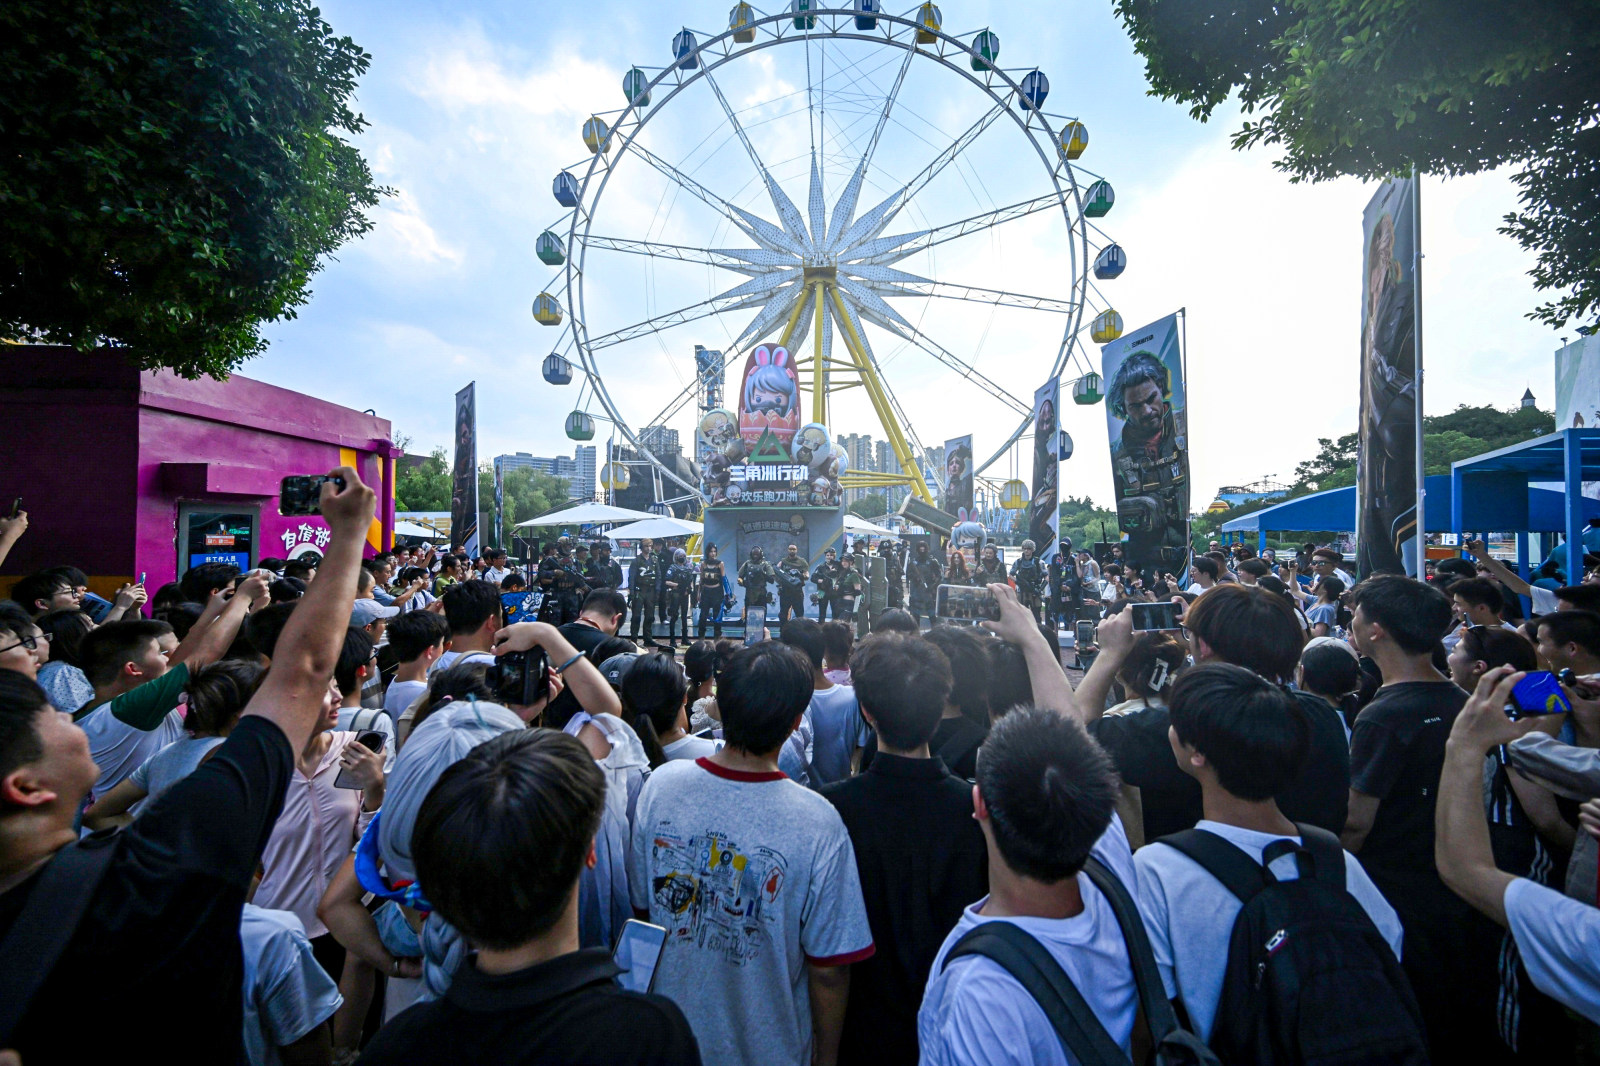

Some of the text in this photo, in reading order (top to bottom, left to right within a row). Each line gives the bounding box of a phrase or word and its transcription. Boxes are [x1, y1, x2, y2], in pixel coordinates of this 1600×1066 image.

[729, 465, 809, 481] 三角洲行动
[741, 490, 798, 503] 欢乐跑刀洲
